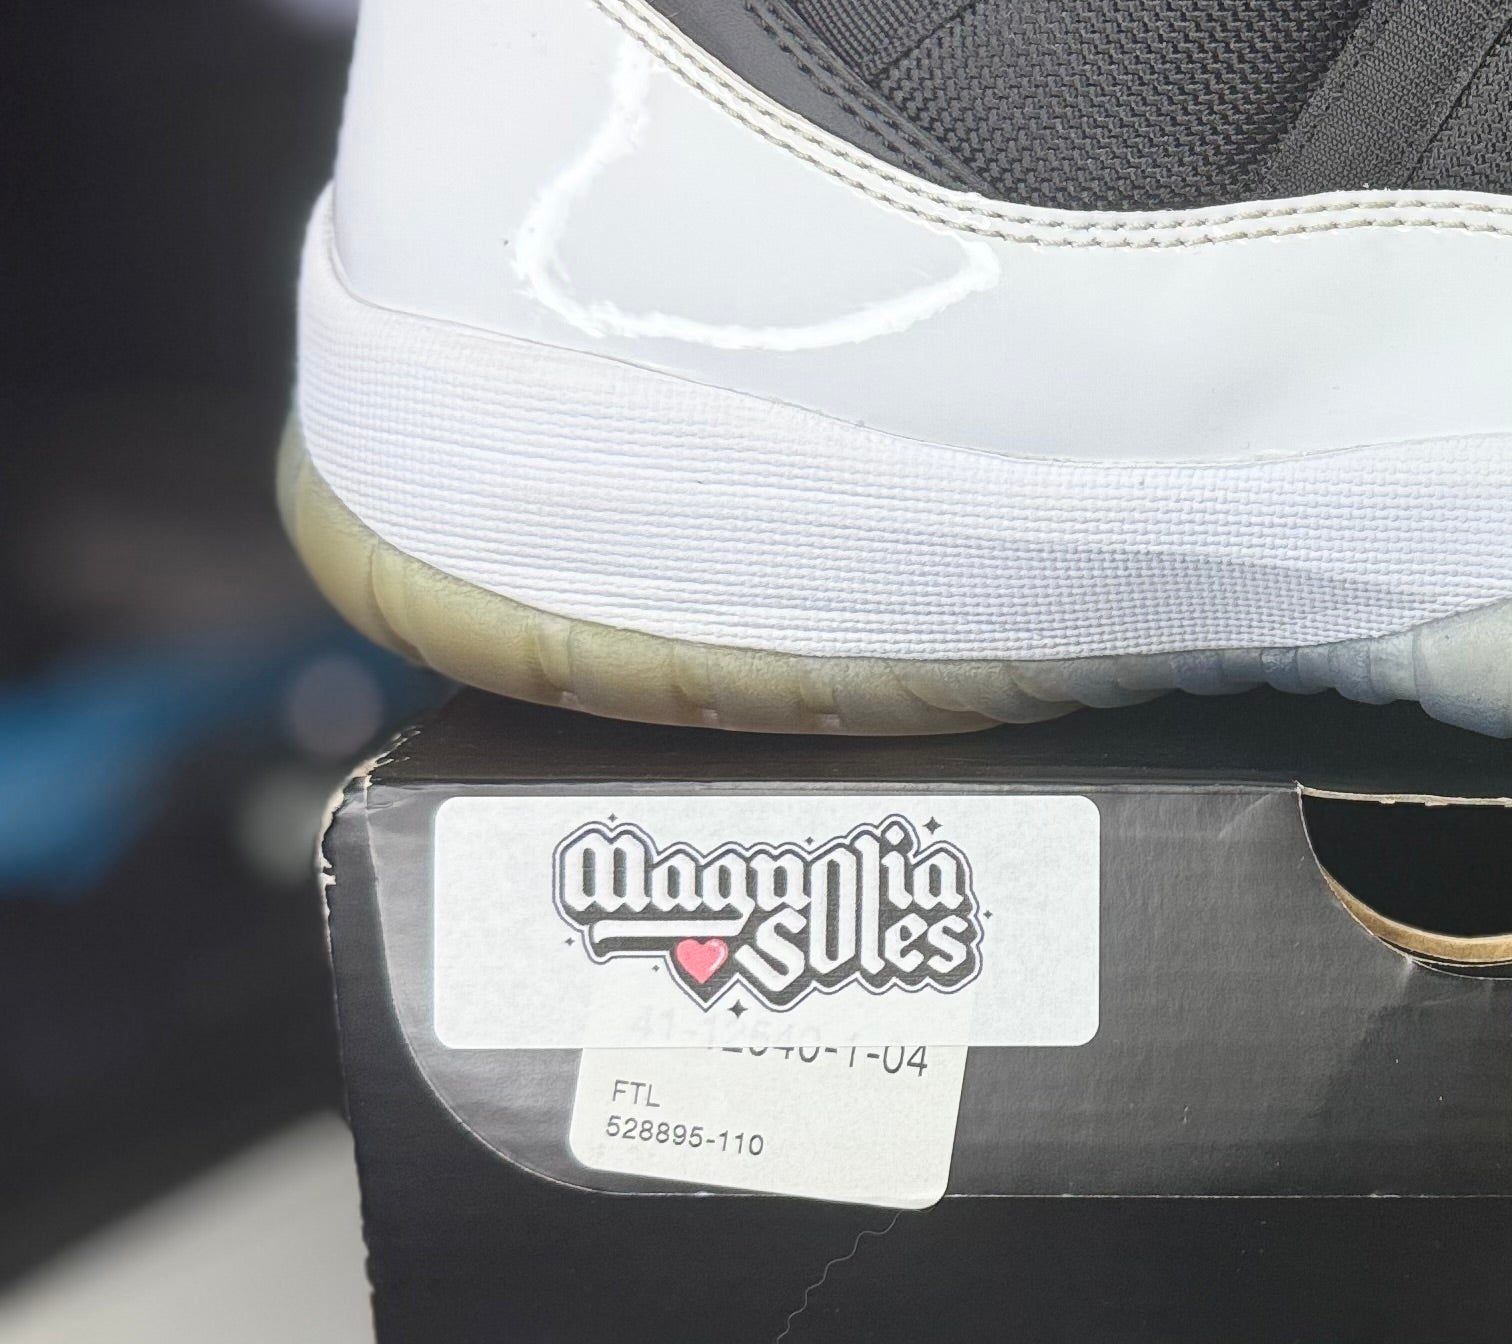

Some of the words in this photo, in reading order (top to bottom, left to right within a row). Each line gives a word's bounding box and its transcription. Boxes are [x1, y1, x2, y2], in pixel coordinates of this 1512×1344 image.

[560, 816, 968, 948] Magnolia
[611, 1079, 661, 1108] FTL
[605, 1114, 764, 1156] 528895-110
